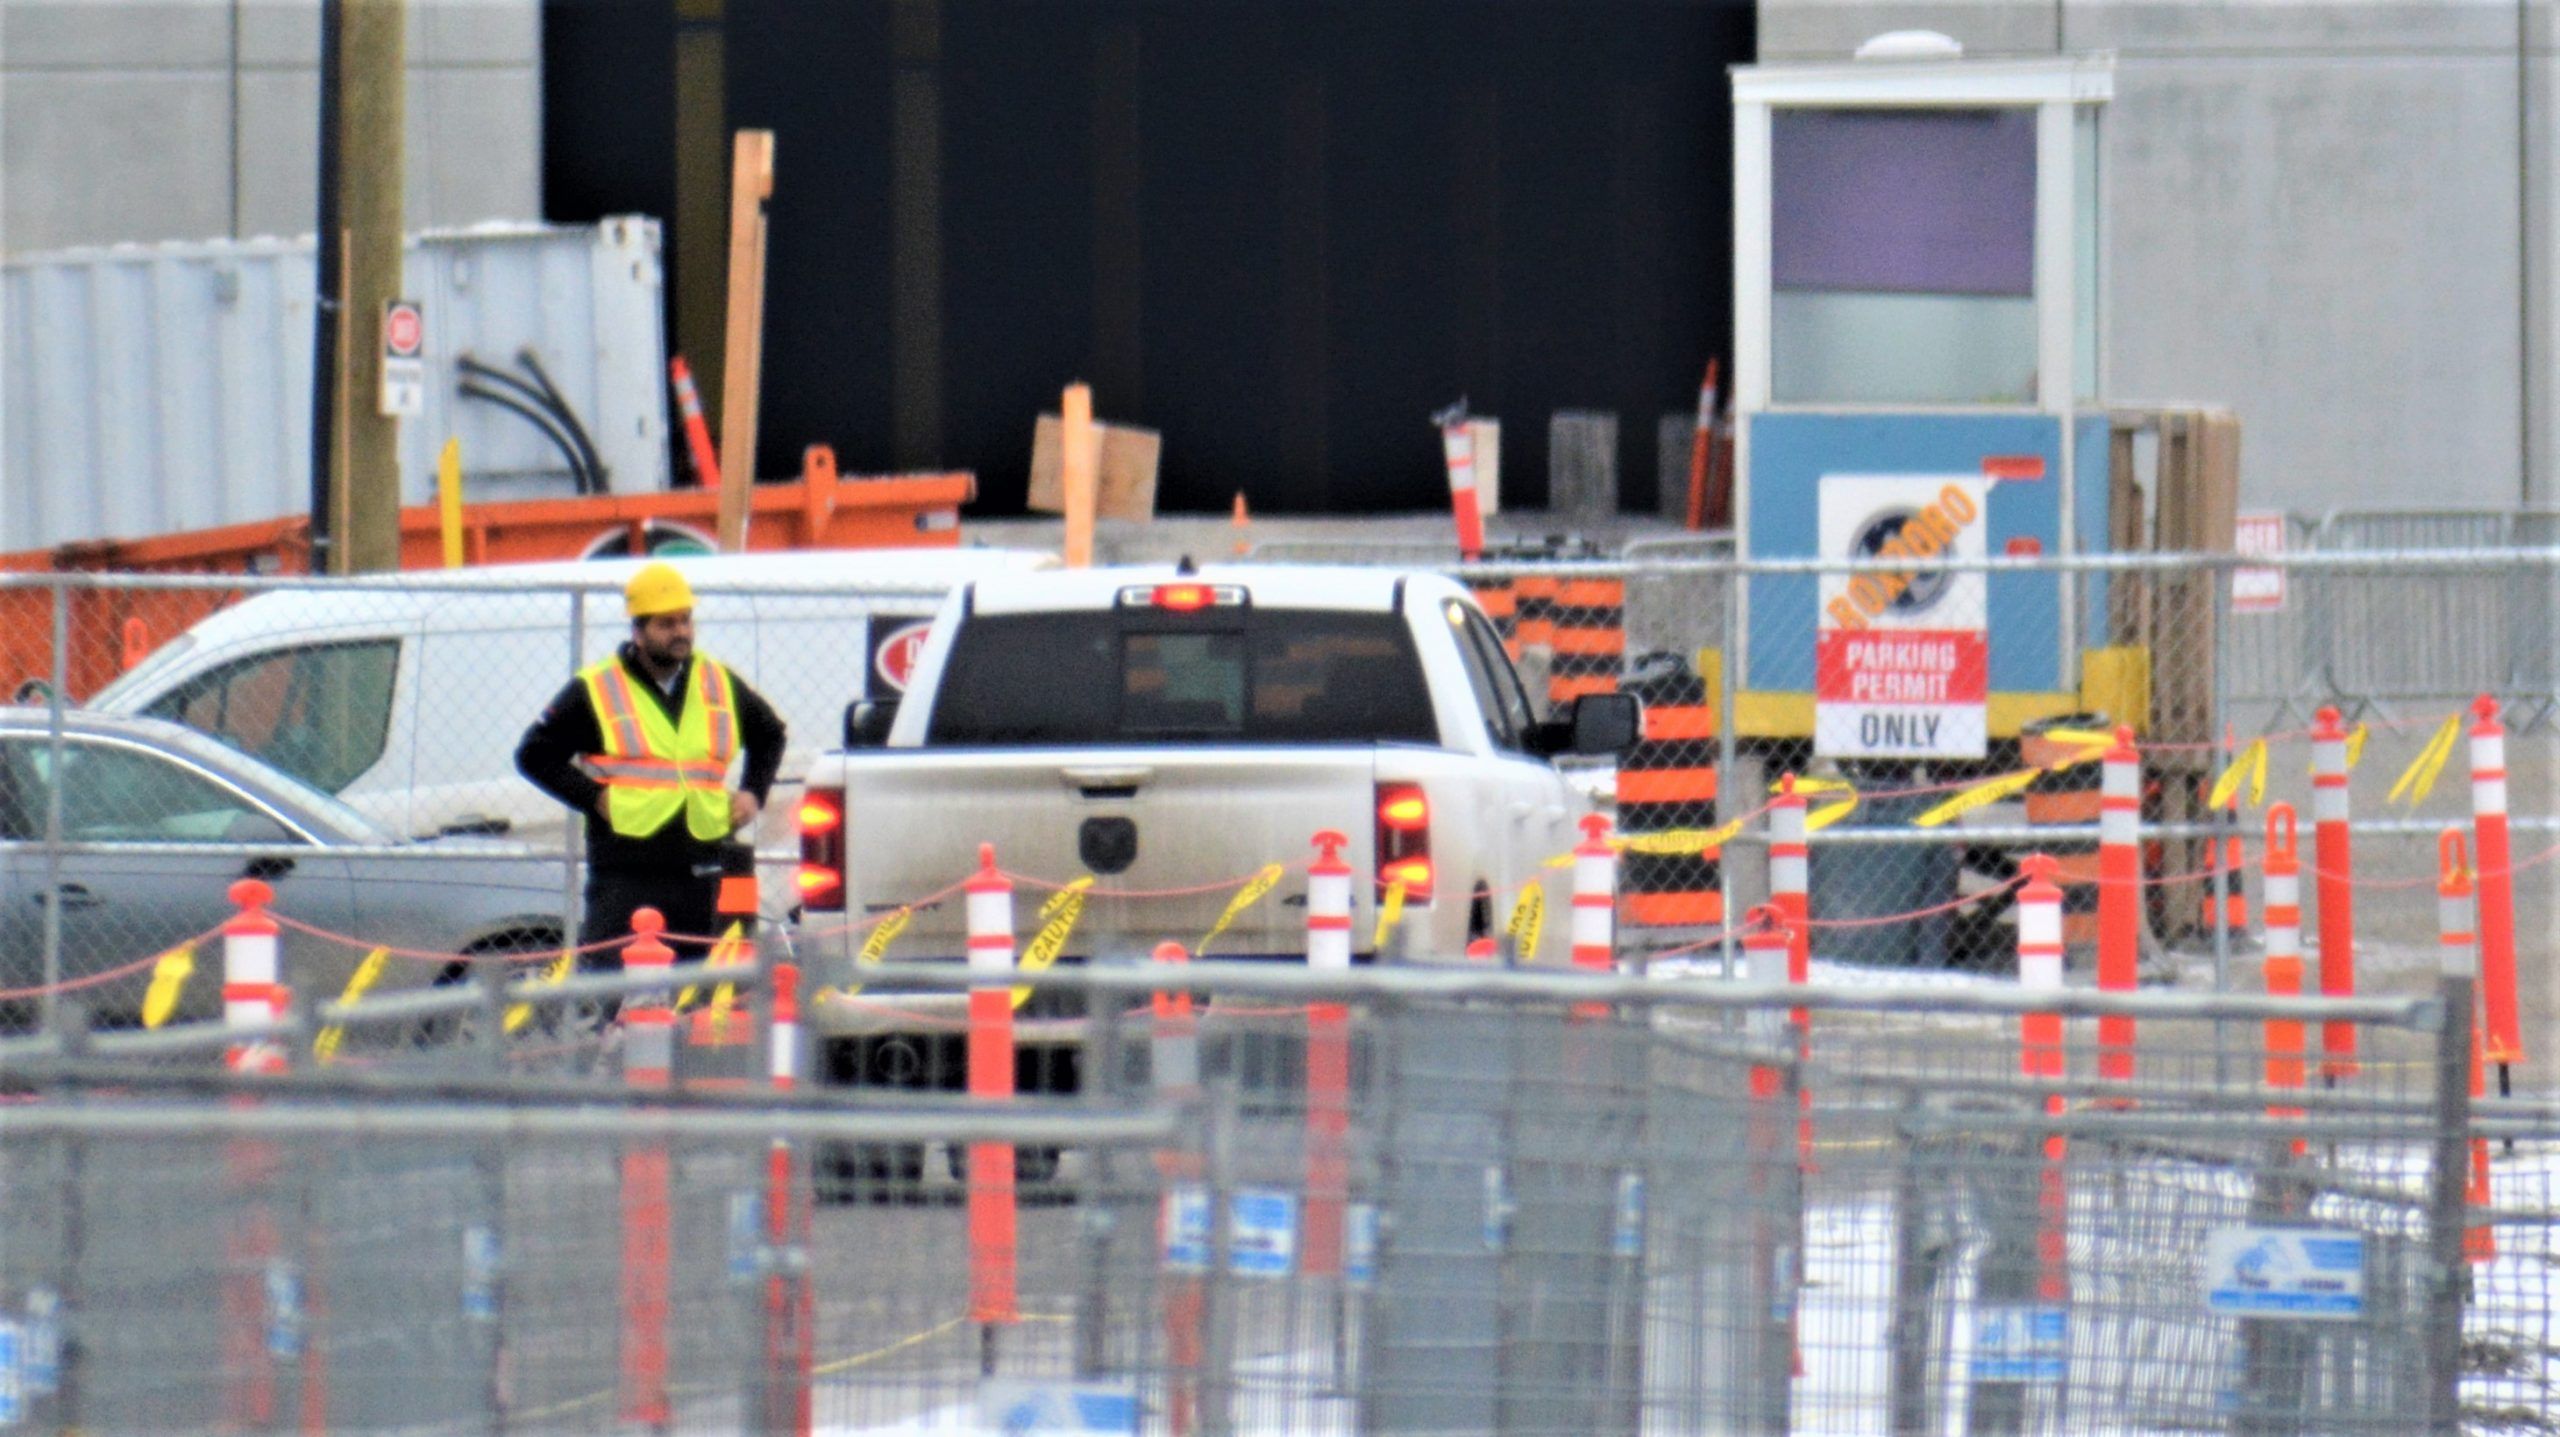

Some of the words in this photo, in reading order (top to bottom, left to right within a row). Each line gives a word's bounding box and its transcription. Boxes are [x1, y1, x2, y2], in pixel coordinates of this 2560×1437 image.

[1845, 642, 1956, 671] PARKING
[1852, 672, 1950, 701] PERMIT
[1861, 713, 1942, 748] ONLY
